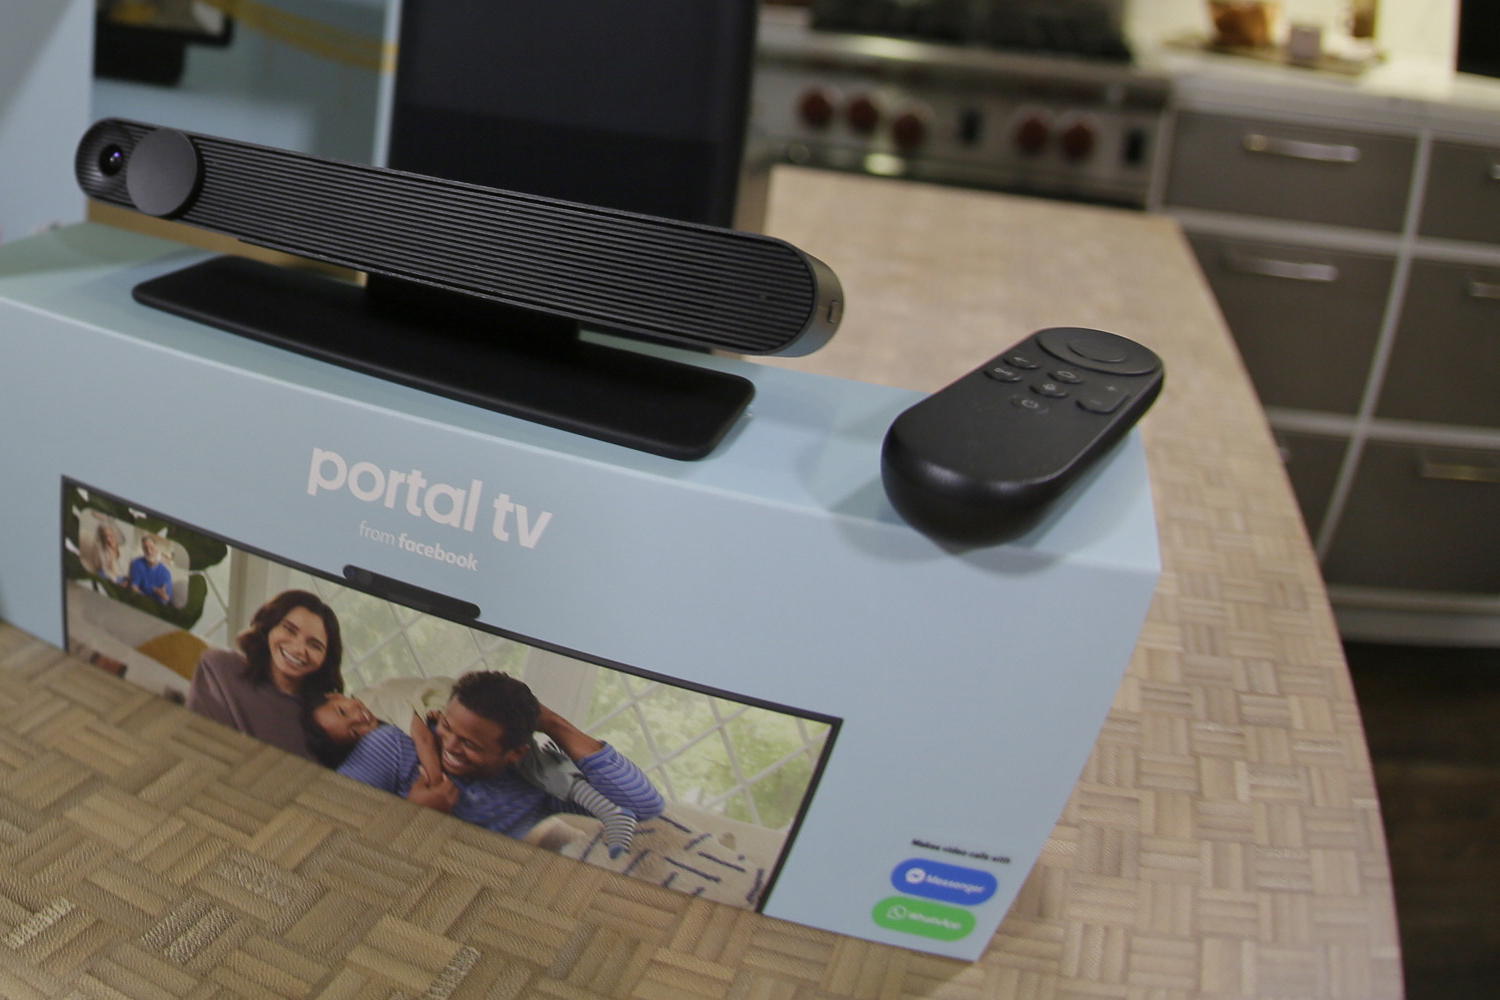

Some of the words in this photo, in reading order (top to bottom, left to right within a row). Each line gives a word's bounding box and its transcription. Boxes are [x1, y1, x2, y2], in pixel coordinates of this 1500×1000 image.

[306, 446, 483, 532] portal
[492, 492, 553, 550] tv
[359, 520, 395, 546] from
[398, 532, 479, 571] facebook
[926, 873, 986, 895] Messenger
